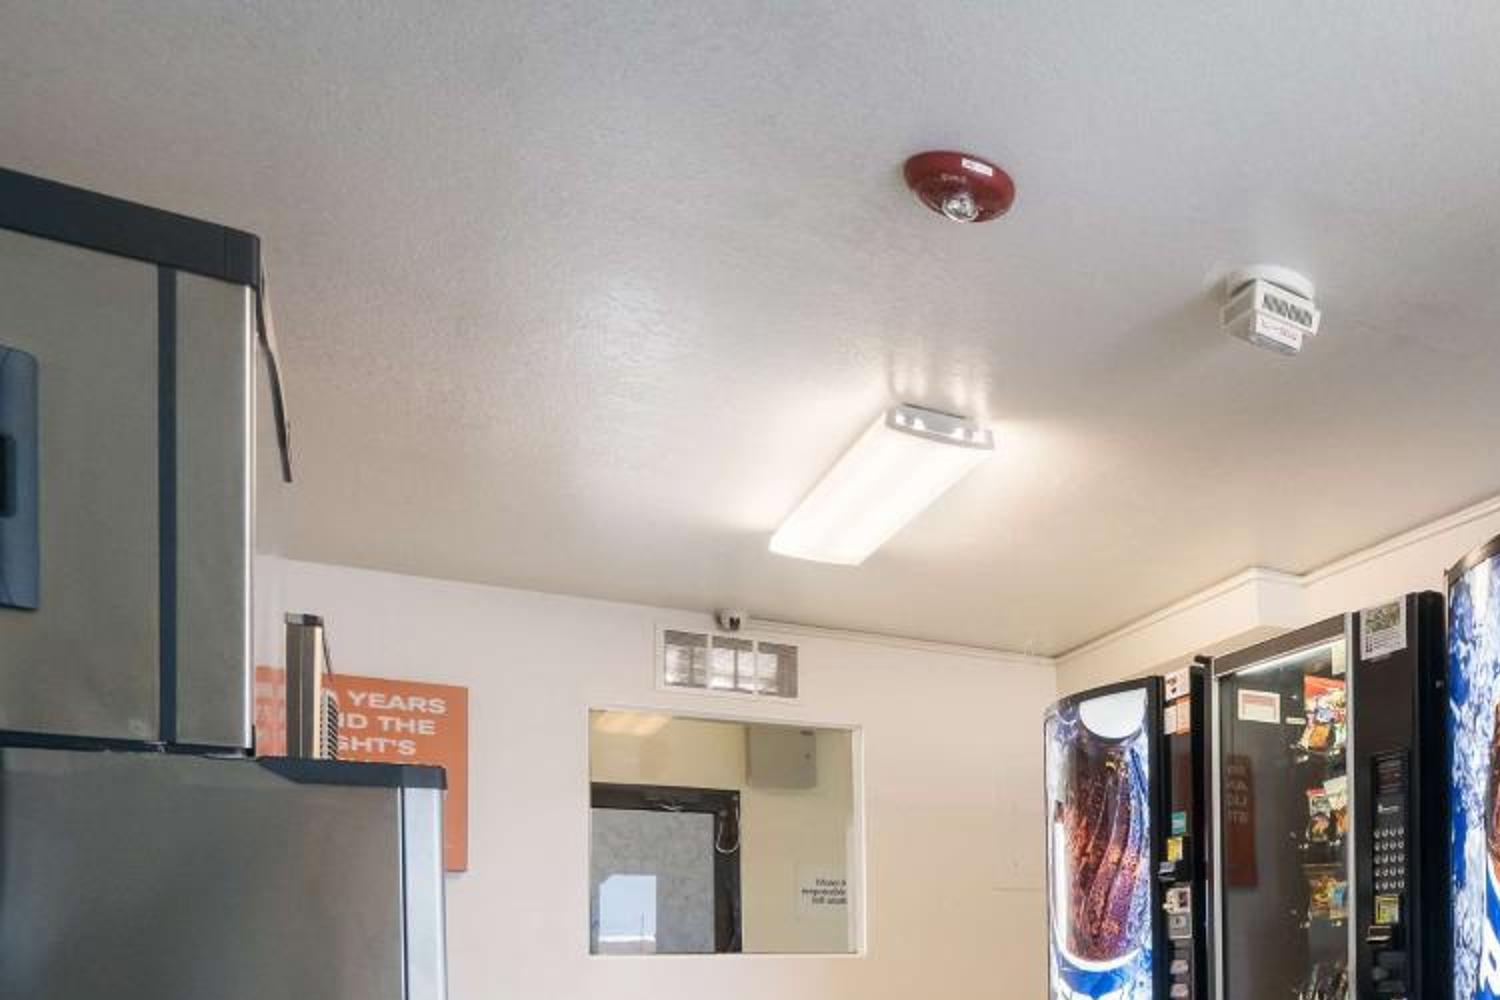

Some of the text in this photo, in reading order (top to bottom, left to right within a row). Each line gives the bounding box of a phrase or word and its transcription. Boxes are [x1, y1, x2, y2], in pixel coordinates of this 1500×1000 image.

[346, 689, 446, 714] YEARS
[377, 715, 437, 735] THE
[337, 735, 417, 756] GHT'S
